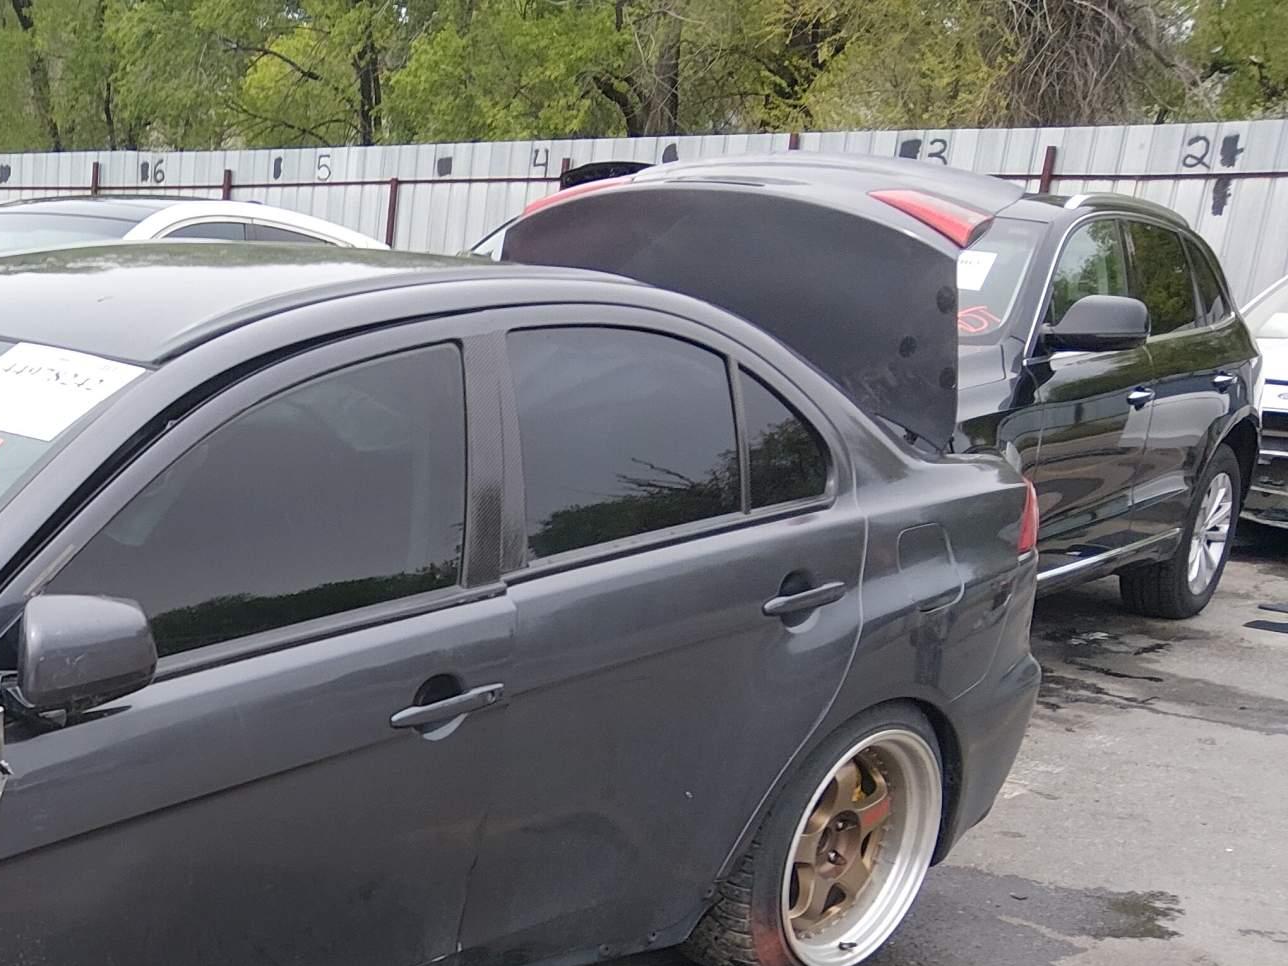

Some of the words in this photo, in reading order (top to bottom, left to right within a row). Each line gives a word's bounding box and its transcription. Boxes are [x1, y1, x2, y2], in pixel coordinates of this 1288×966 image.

[532, 148, 549, 177] 4
[1182, 135, 1210, 170] 2
[153, 158, 165, 183] 6
[317, 154, 331, 181] 5
